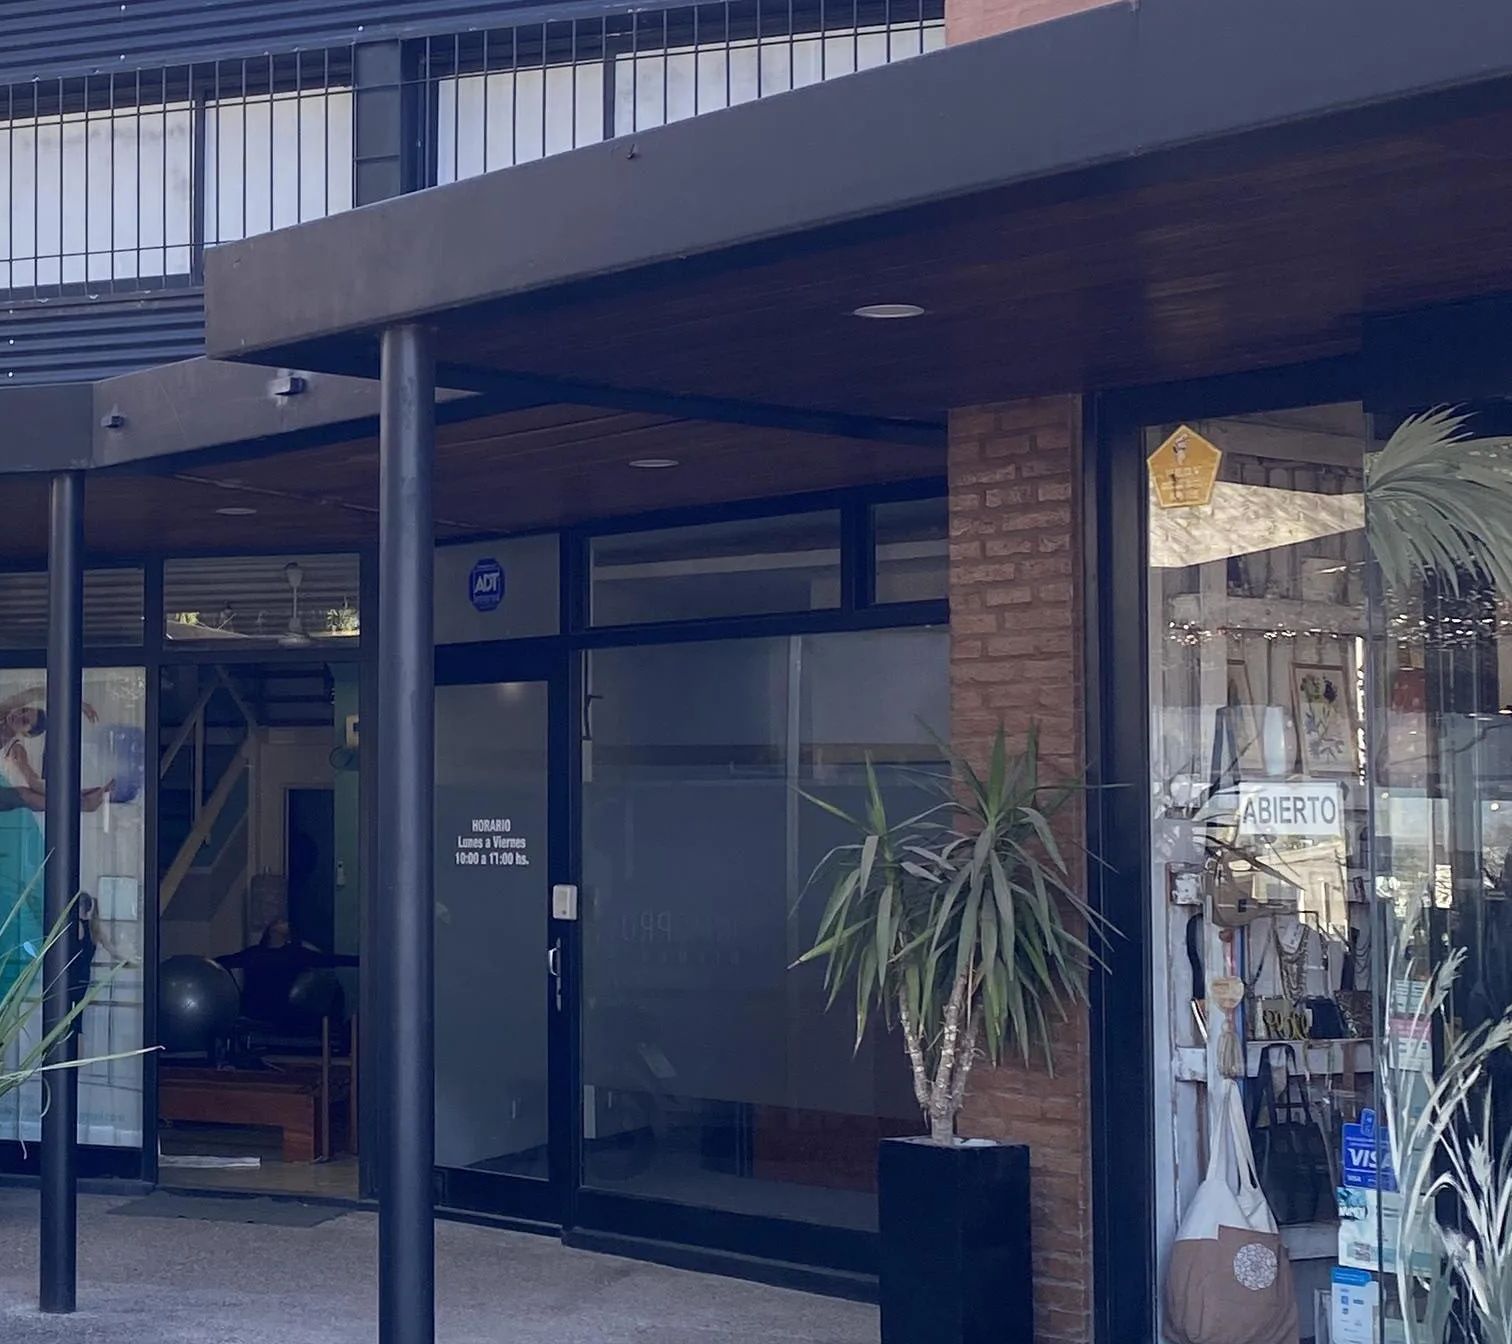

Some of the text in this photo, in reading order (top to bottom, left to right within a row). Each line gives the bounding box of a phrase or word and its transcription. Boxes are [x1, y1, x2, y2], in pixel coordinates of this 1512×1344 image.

[474, 572, 500, 593] ADT
[1243, 796, 1336, 824] ABIERTO
[472, 819, 511, 832] HORARIO
[458, 836, 526, 849] Lunes a Viernes
[455, 852, 479, 865] 10:00
[481, 854, 487, 865] a
